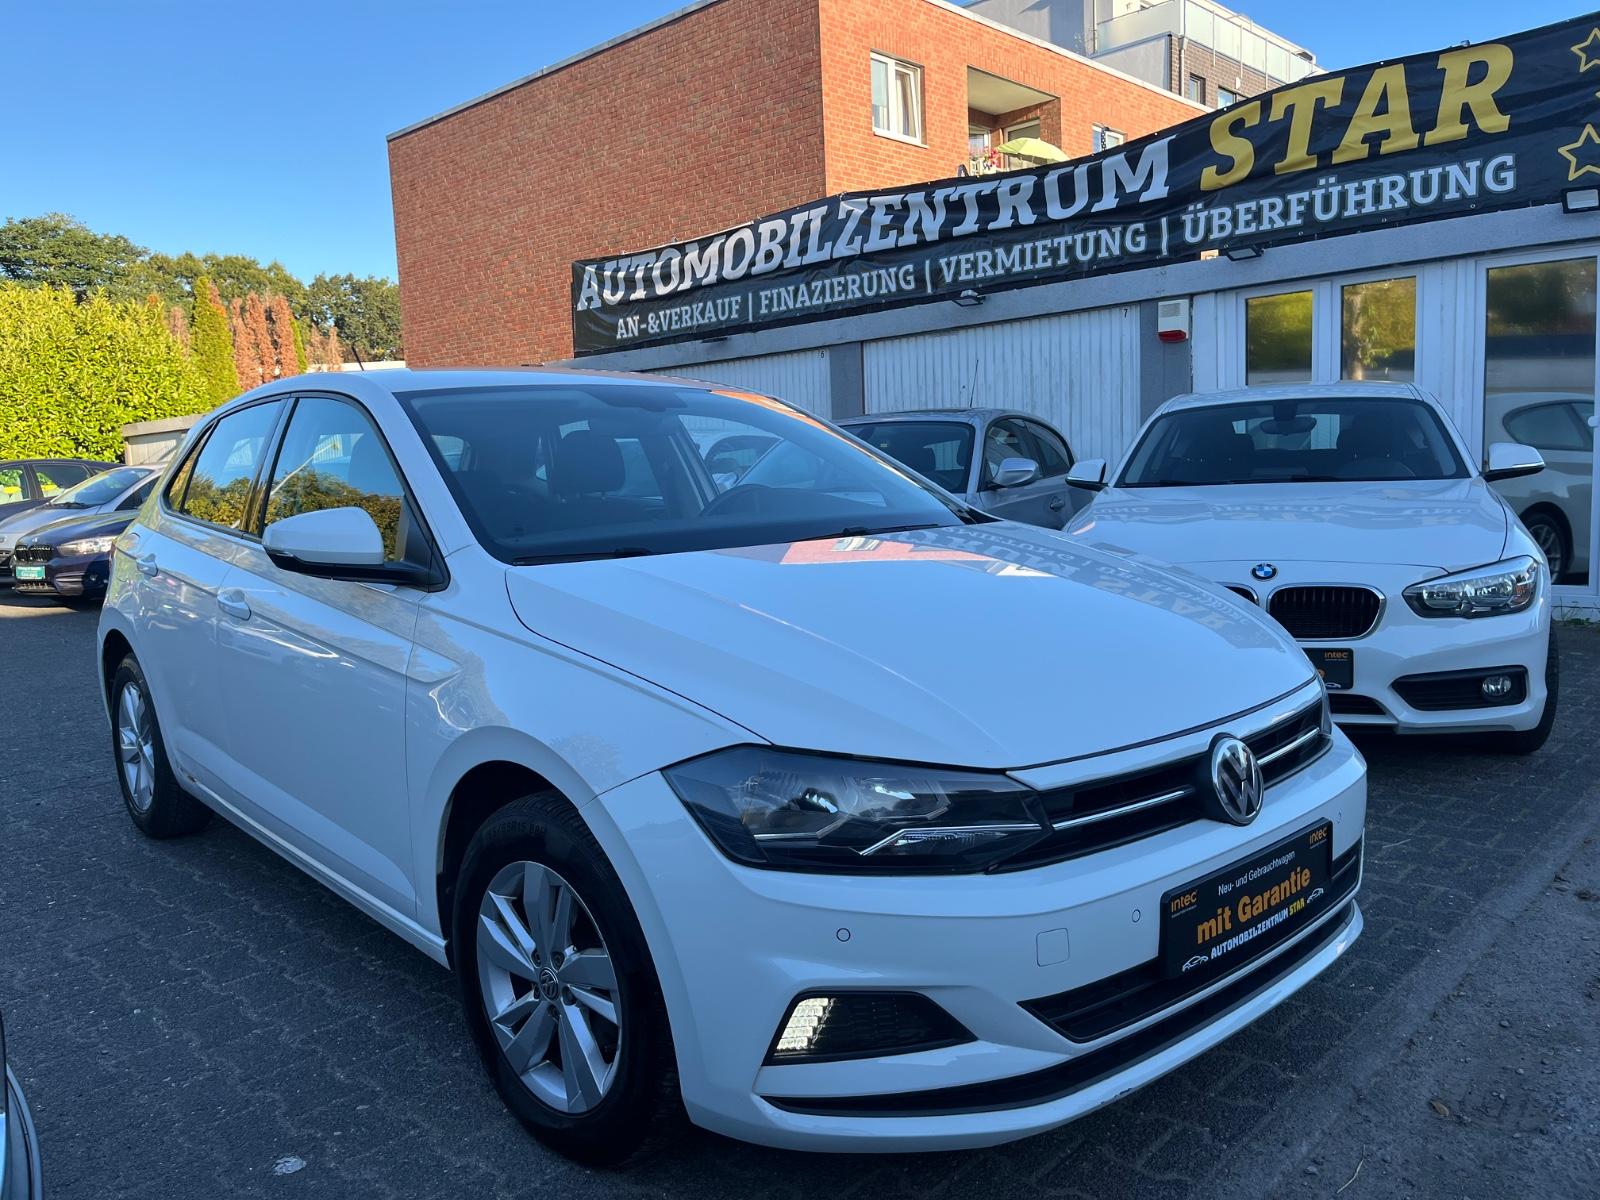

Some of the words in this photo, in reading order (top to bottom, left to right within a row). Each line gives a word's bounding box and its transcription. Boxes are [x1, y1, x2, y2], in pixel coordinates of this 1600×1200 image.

[577, 134, 1177, 311] AUTOMOBILZENTRUM
[1200, 44, 1514, 190] STAR
[617, 295, 741, 339] AN-&VERKAUF
[759, 267, 916, 314] FINAZIERUNG
[939, 224, 1147, 283] VERMIETUNG
[1181, 155, 1516, 244] ÜBERFÜHRUNG
[1197, 906, 1232, 944] mit
[1238, 866, 1312, 923] Garantie
[1218, 882, 1235, 896] Neu-
[1235, 873, 1248, 888] und
[1248, 850, 1296, 881] Gebrauchtwagen
[1211, 907, 1289, 960] AUTOMOBILZENTRUM
